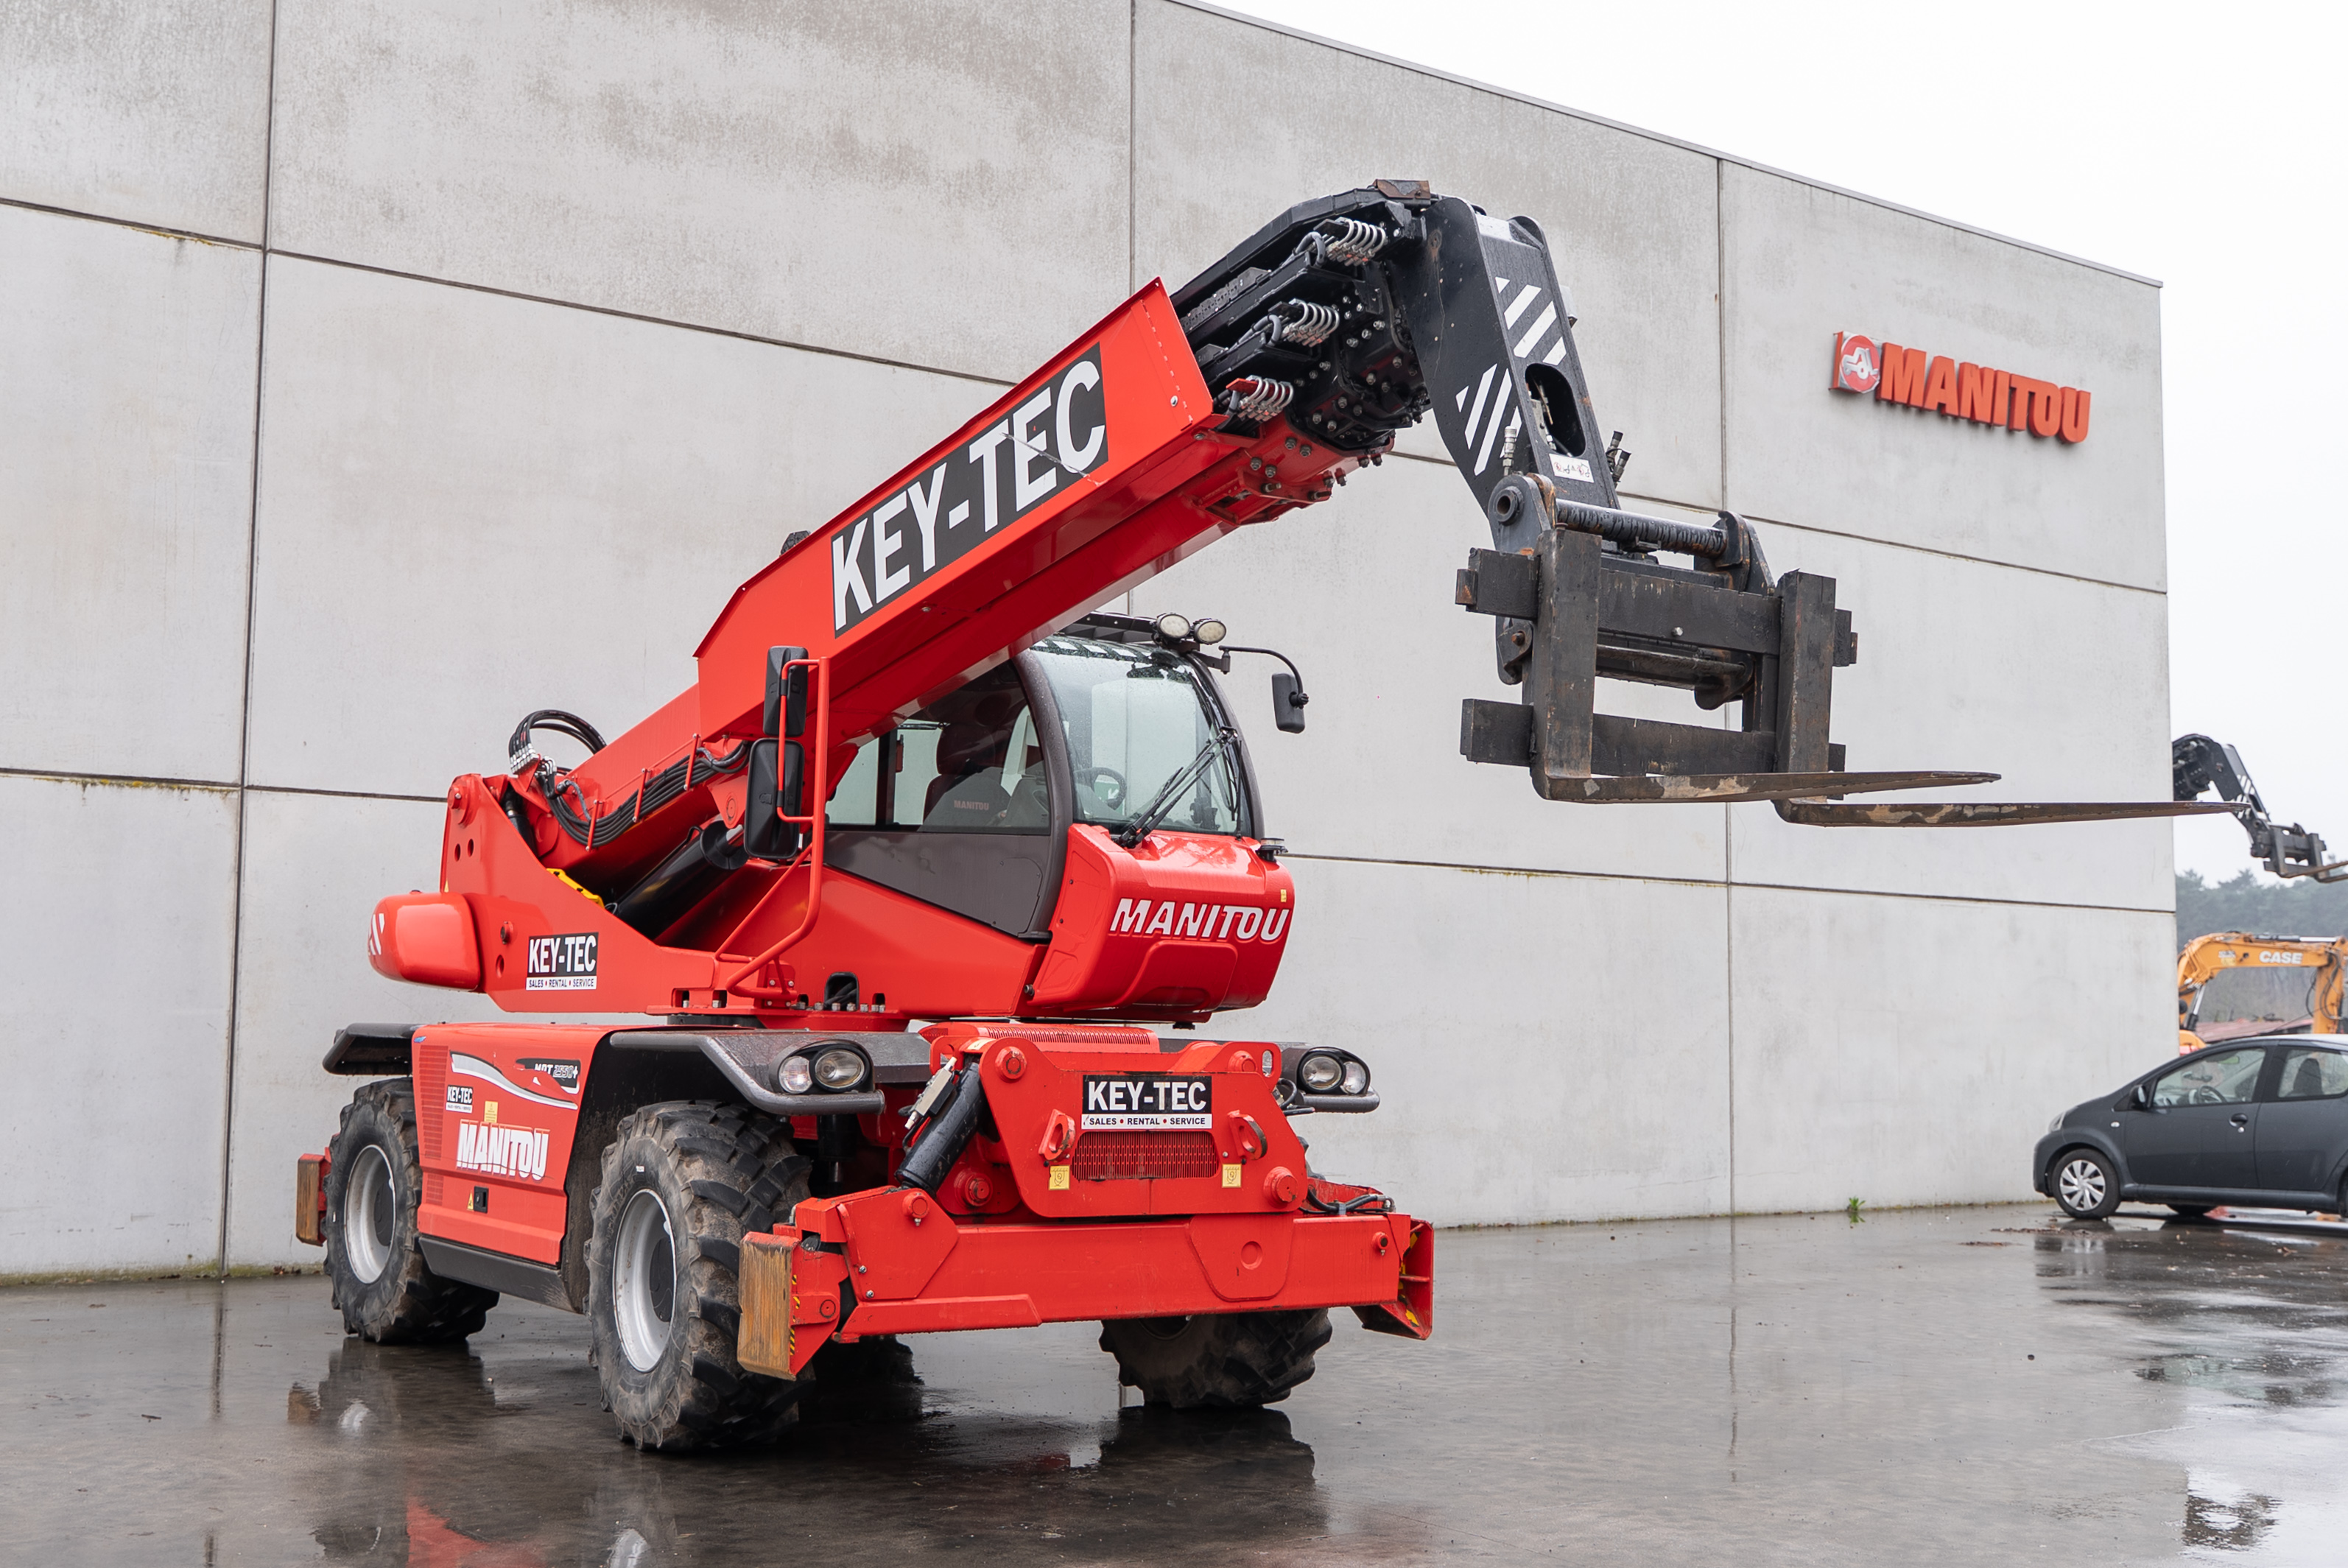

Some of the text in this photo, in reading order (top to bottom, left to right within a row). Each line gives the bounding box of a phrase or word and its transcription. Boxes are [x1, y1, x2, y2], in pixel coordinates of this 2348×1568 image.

[1875, 342, 2092, 443] MANITOU
[832, 359, 1106, 631] KEY-TEC
[954, 800, 990, 811] MANITOU
[1108, 897, 1291, 943] MANITOU
[528, 935, 597, 974] KEY-TEC
[2259, 950, 2303, 965] CASE
[529, 978, 594, 988] SALES RENTAL SERVICE
[446, 1086, 474, 1104] KEY-TEC
[1088, 1080, 1207, 1111] KEY-TEC
[1089, 1117, 1117, 1125] SALES
[1127, 1117, 1160, 1125] RENTAL
[456, 1122, 550, 1181] MANITOU
